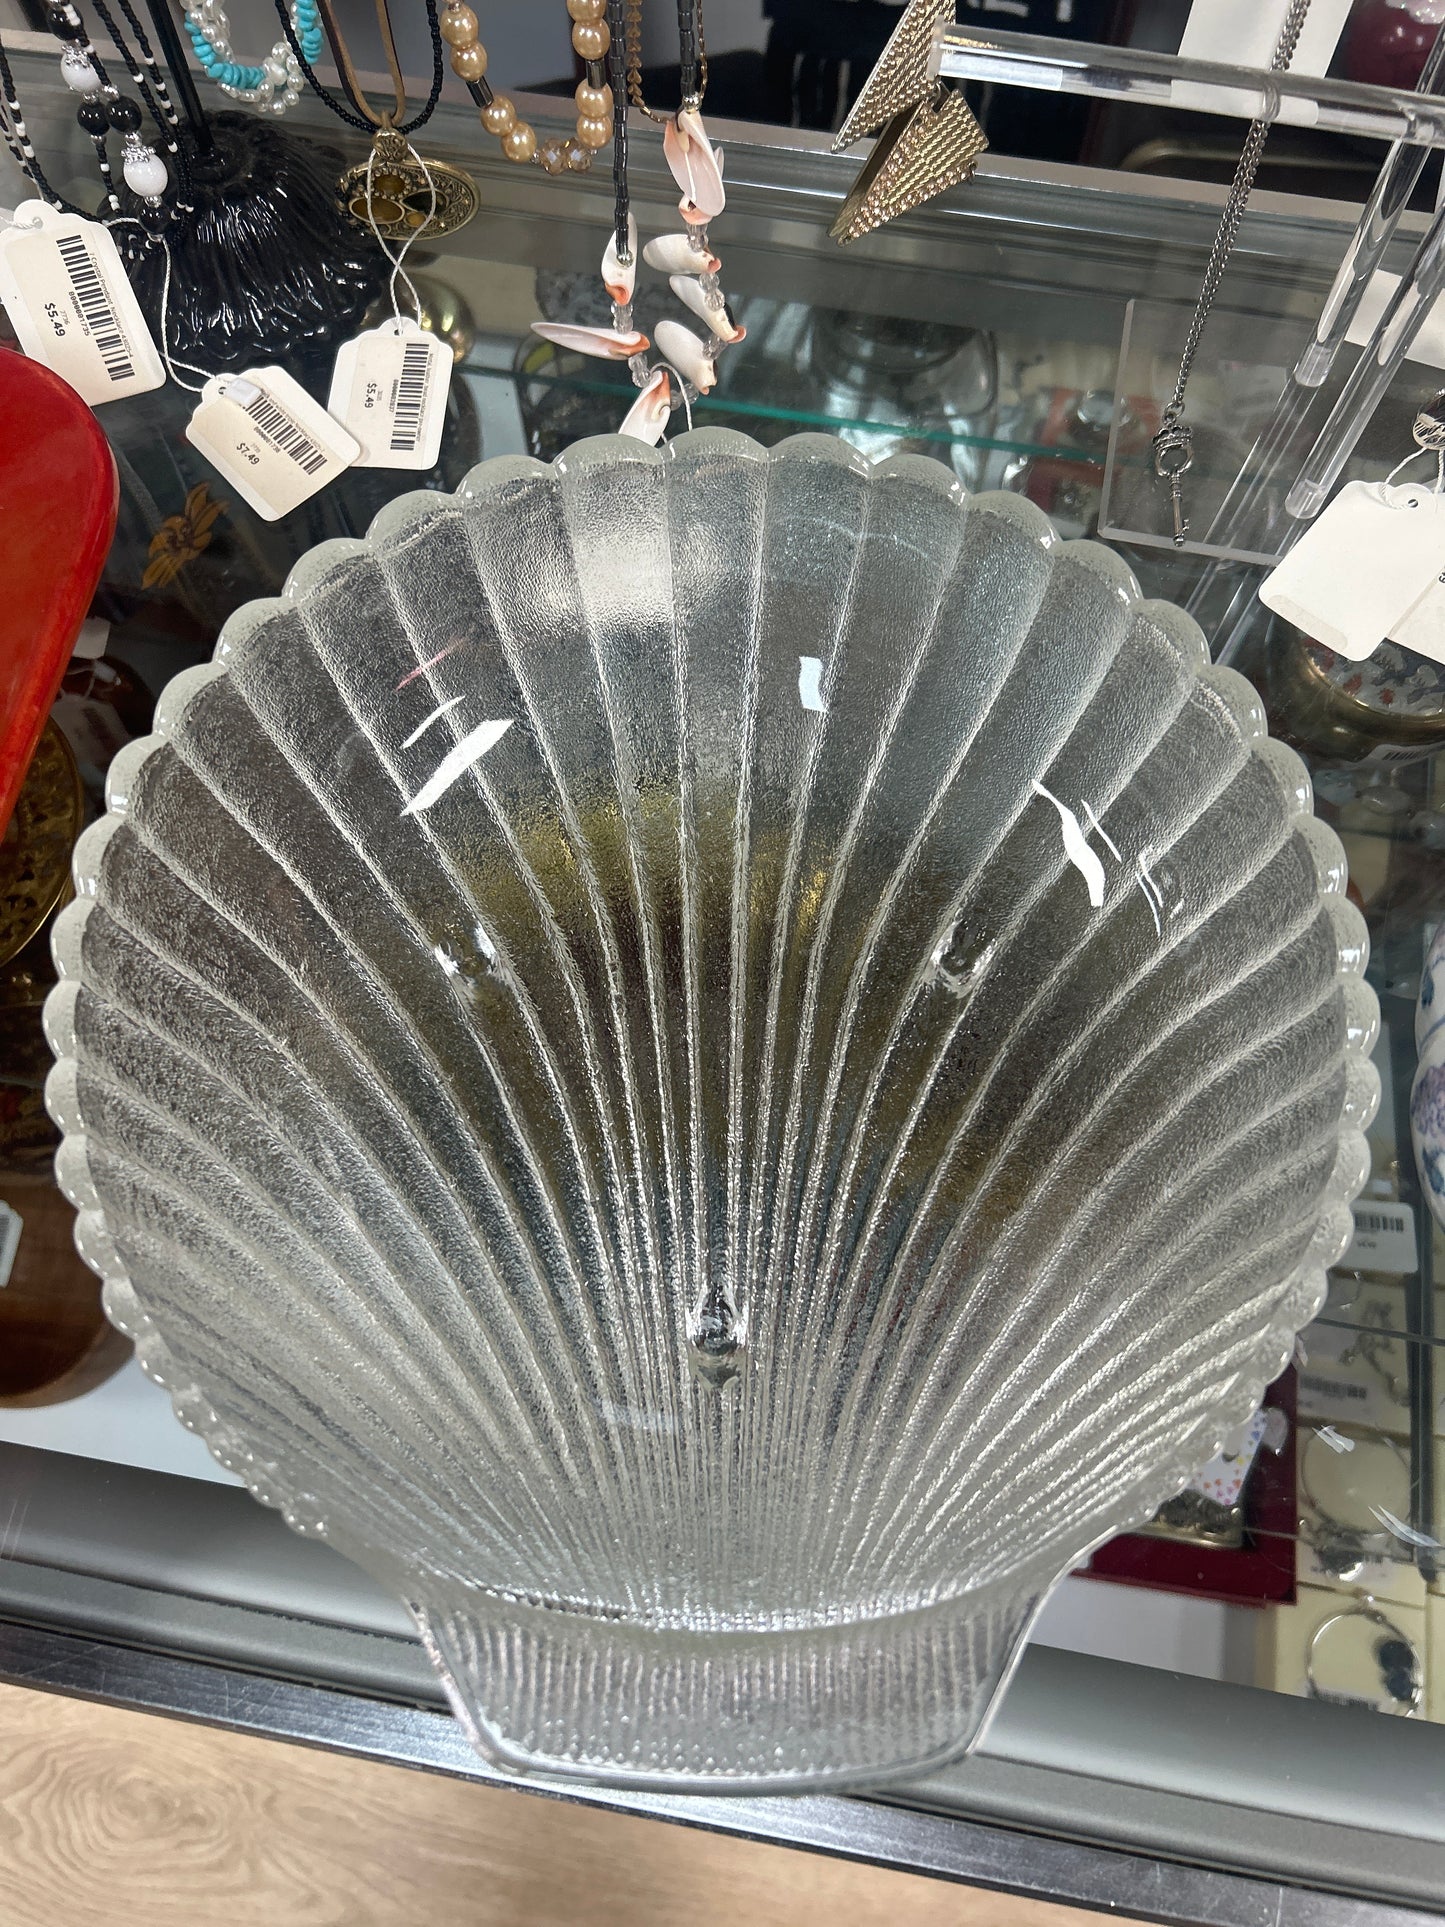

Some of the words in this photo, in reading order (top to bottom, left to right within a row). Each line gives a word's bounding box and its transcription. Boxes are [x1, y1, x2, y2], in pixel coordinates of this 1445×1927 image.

[90, 256, 103, 278] Crystal
[99, 279, 113, 304] Pendant
[110, 306, 124, 333] Necklace
[43, 301, 66, 337] $5.49
[364, 382, 377, 408] $5.49
[235, 441, 260, 466] $7.49
